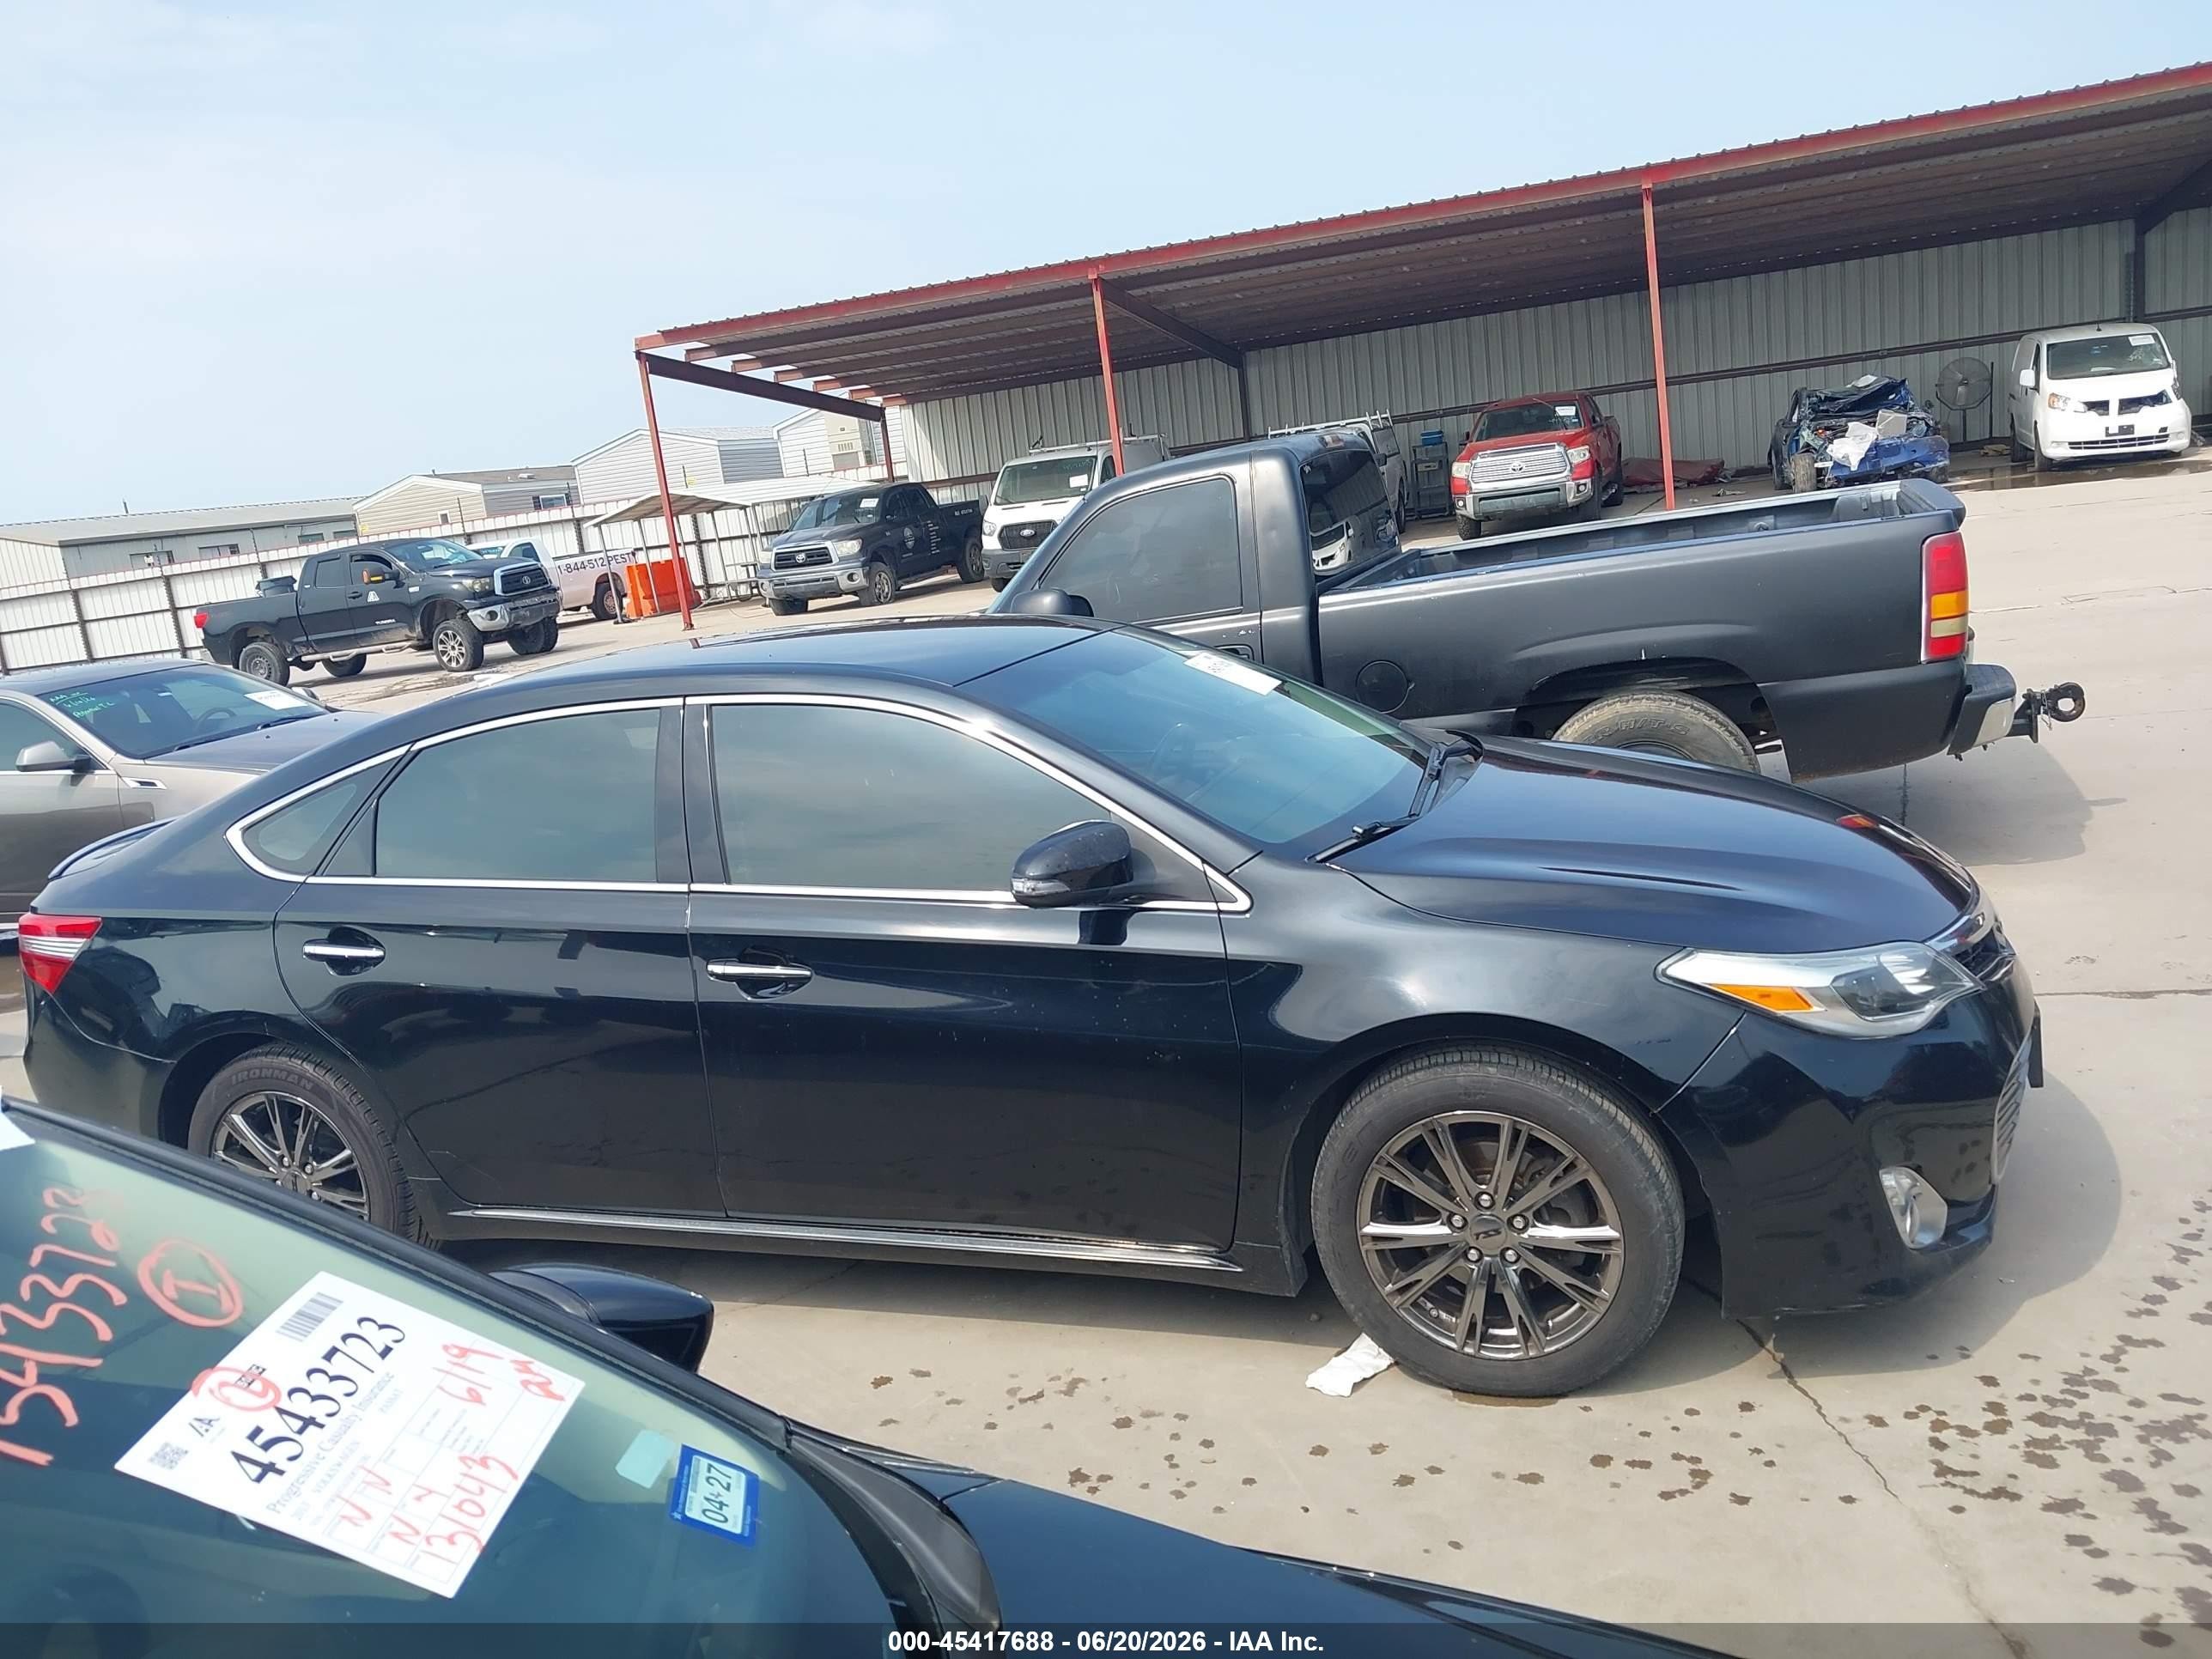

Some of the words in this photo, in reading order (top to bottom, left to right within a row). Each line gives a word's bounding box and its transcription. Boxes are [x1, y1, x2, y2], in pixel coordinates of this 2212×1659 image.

[229, 1316, 407, 1485] 45433723
[265, 1453, 325, 1513] Progressive
[317, 1413, 363, 1450] Casualty
[352, 1370, 396, 1412] Insurance
